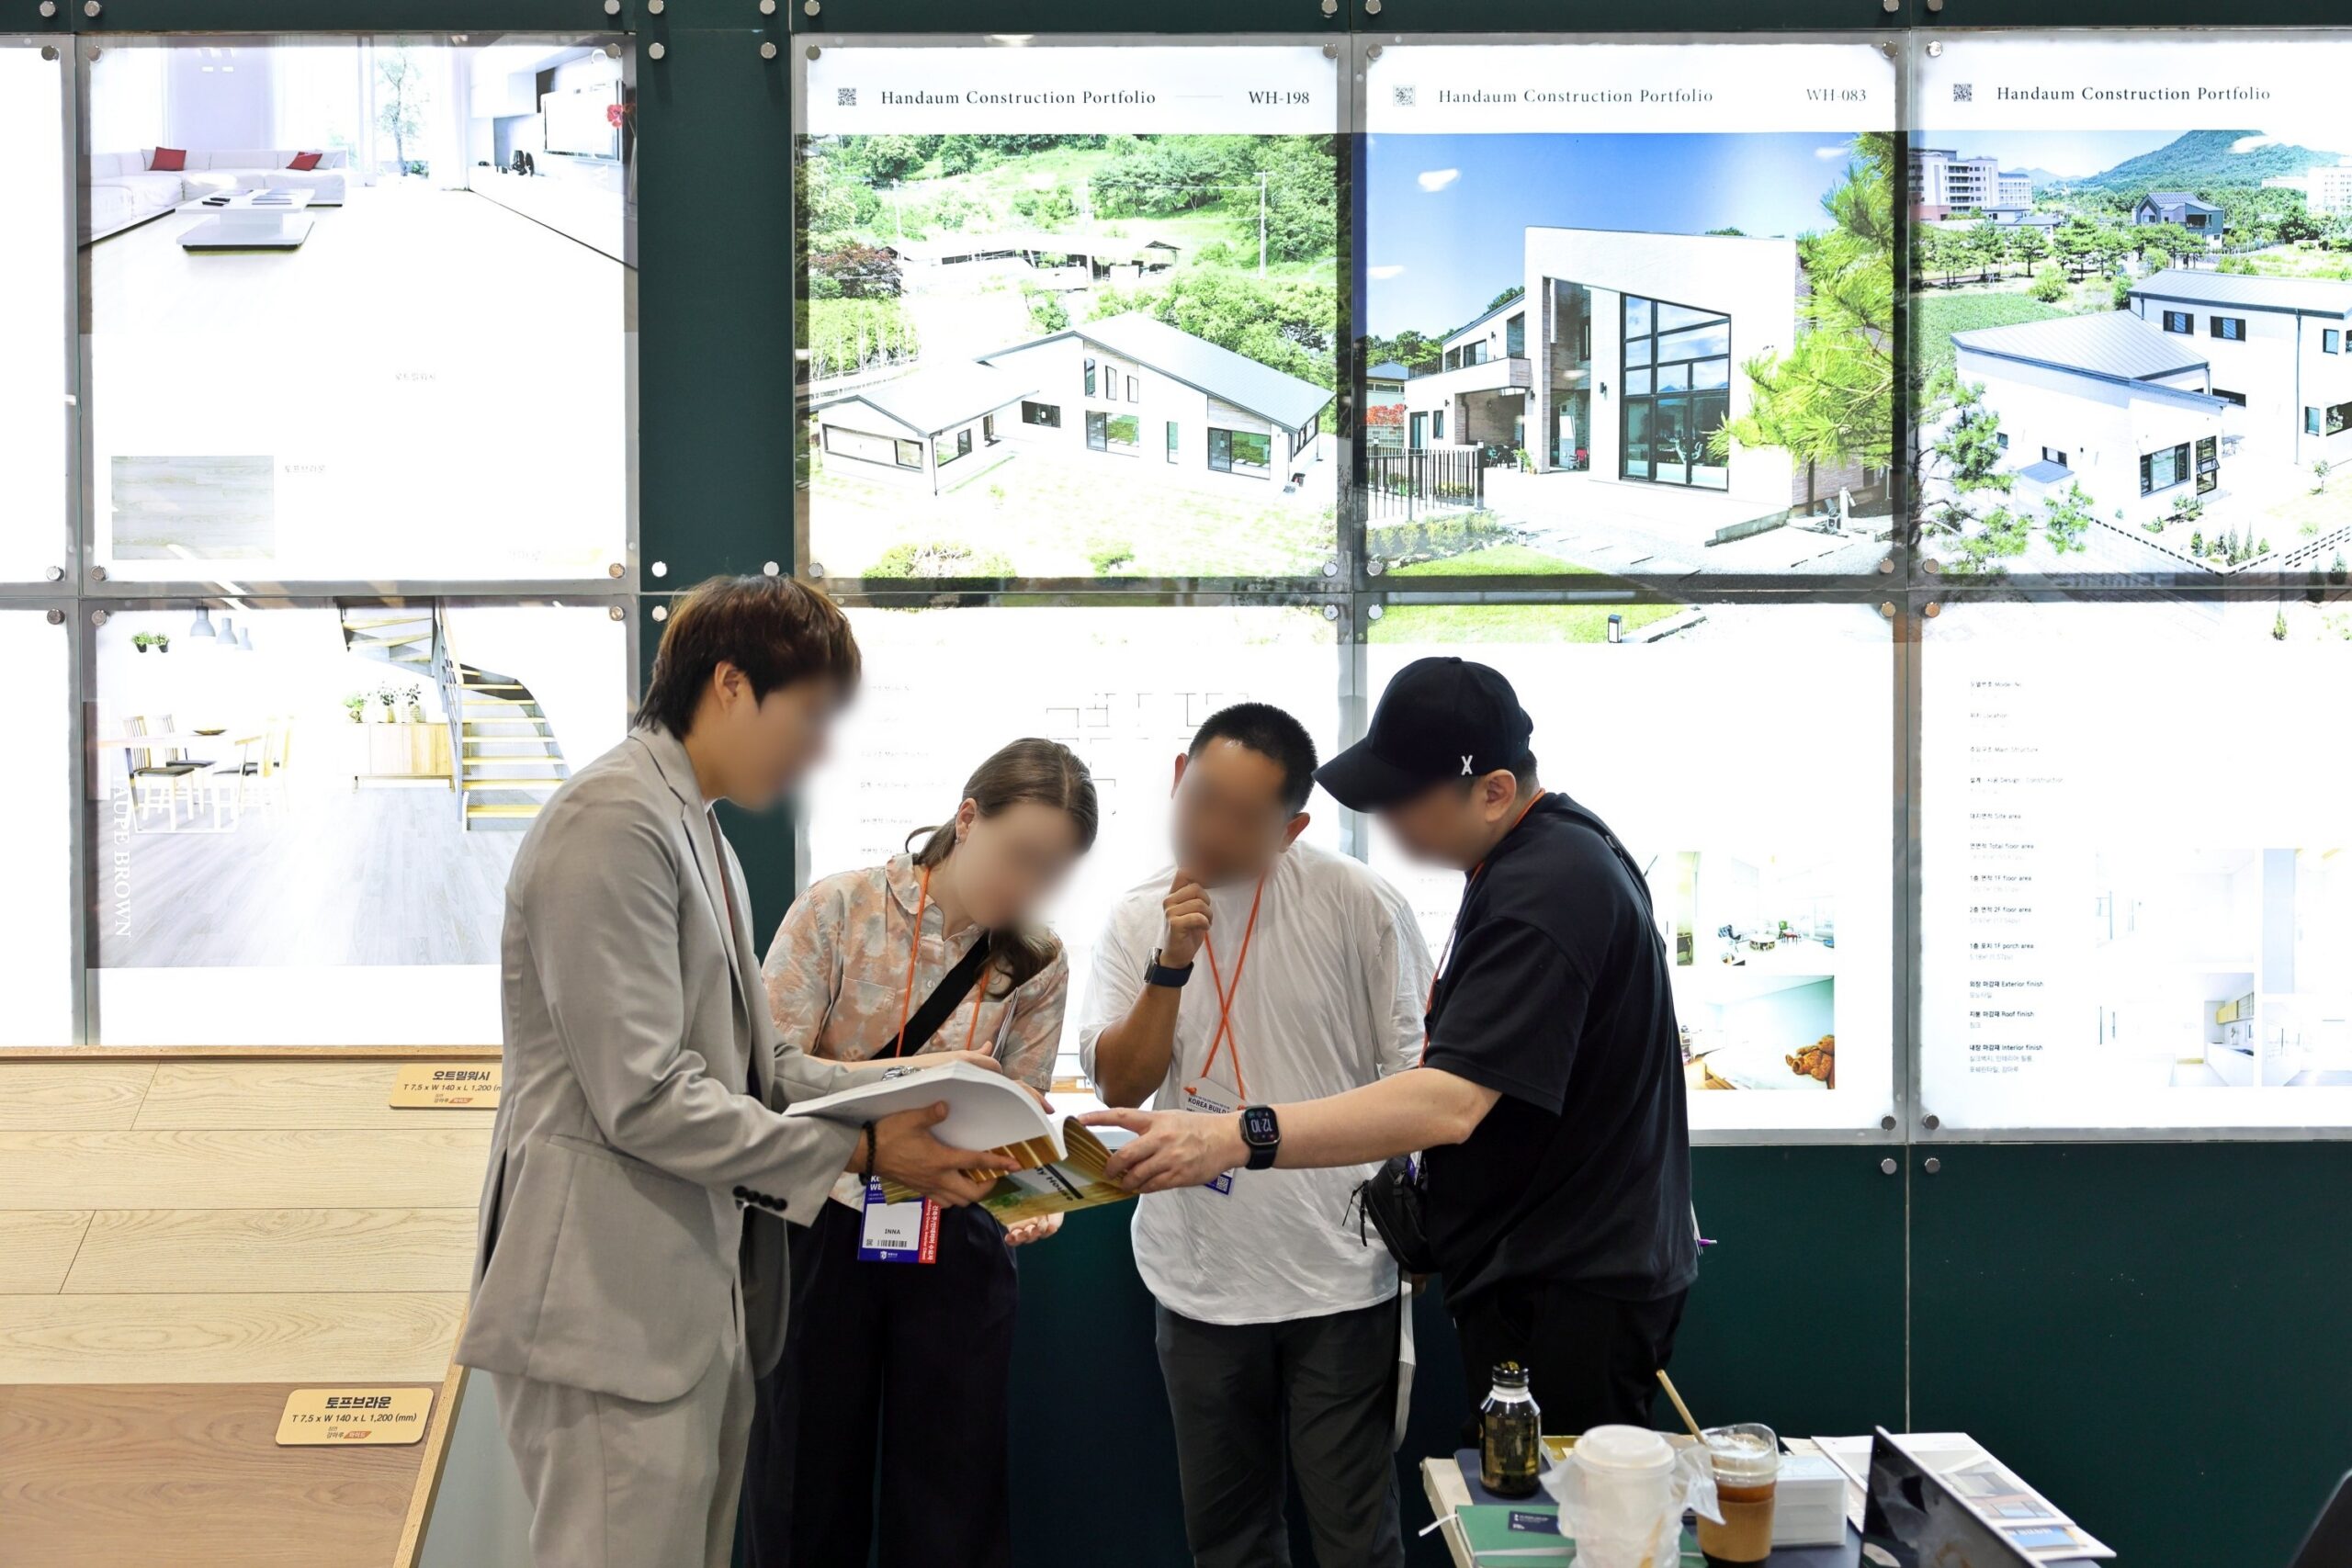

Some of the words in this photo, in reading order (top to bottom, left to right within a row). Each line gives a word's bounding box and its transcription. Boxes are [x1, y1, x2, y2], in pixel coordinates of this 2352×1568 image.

[882, 91, 958, 104] Handaum
[967, 91, 1074, 103] Construction
[1084, 90, 1155, 103] Portfolio
[1249, 91, 1309, 104] WH-198
[1440, 89, 1516, 102] Handaum
[1524, 90, 1632, 102] Construction
[1641, 89, 1713, 102] Portfolio
[1807, 89, 1866, 101] WH-083
[1998, 86, 2074, 100] Handaum
[2082, 87, 2189, 100] Construction
[2199, 86, 2269, 99] Portfolio
[114, 851, 131, 938] BROWN
[433, 1071, 491, 1081] 오트밀워시
[1188, 1097, 1207, 1110] KOREA
[325, 1396, 391, 1409] 토프브라운
[300, 1415, 314, 1423] 7.5
[369, 1414, 393, 1422] 1,200
[395, 1413, 417, 1423] (mm)
